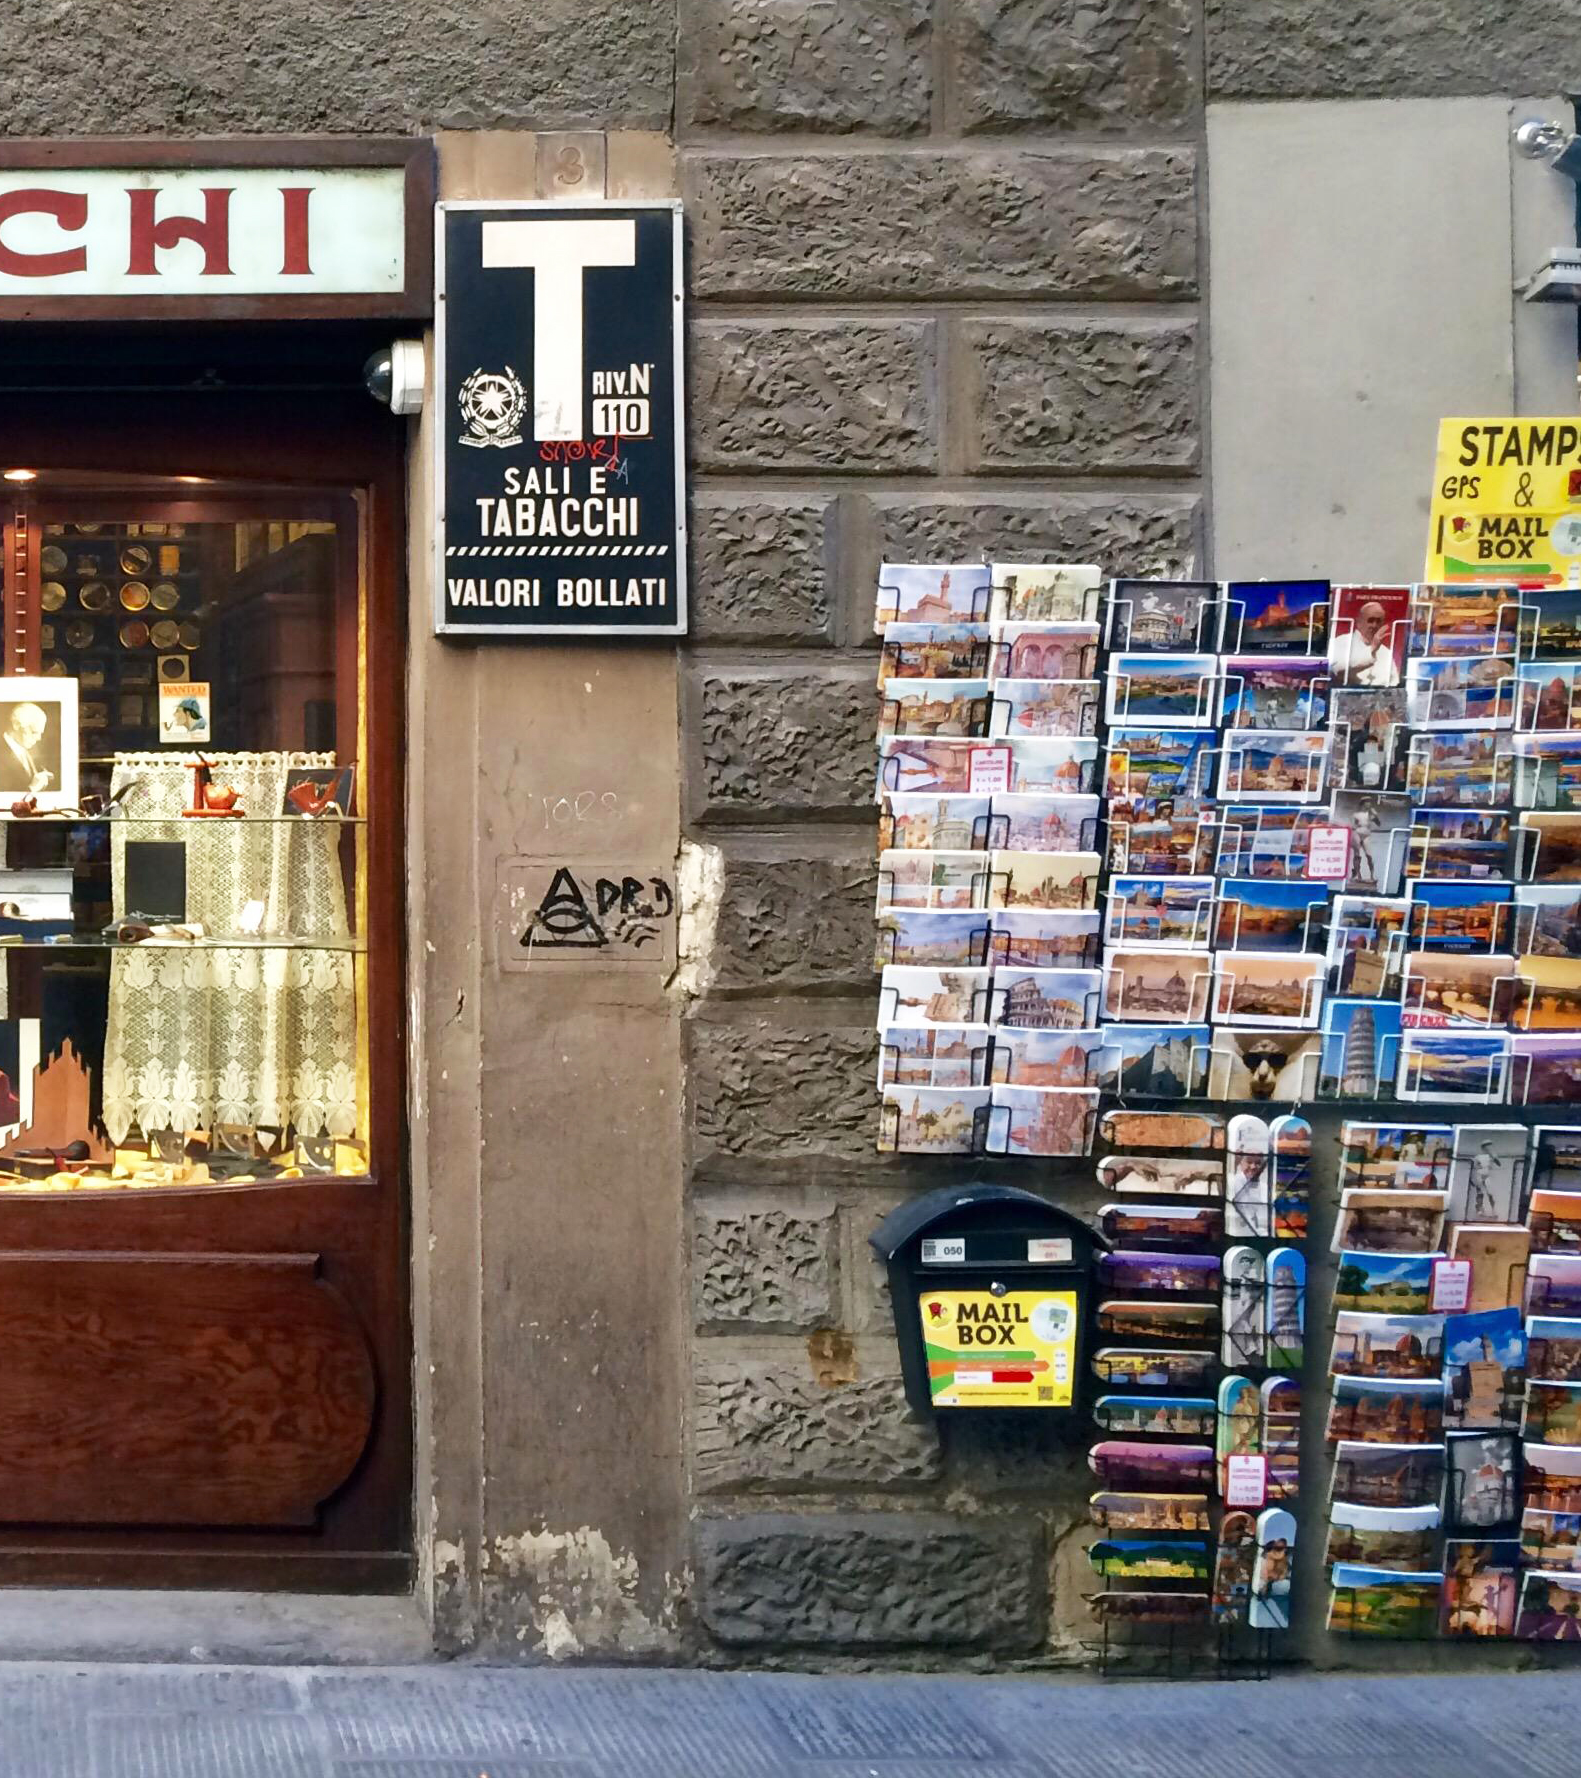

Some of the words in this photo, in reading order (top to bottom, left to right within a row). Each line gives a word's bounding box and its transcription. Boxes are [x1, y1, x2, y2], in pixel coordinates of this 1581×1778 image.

[558, 147, 584, 184] 3
[482, 220, 635, 441] T
[601, 403, 641, 432] 110
[1459, 426, 1581, 466] STAMP
[505, 467, 570, 494] SALI
[590, 467, 606, 494] E
[1442, 475, 1481, 499] GPS
[1515, 472, 1533, 507] &
[477, 499, 637, 536] TABACCHI
[1478, 518, 1548, 537] MAIL
[1478, 540, 1534, 558] BOX
[448, 579, 540, 607] VALORI
[558, 578, 666, 606] BOLLATI
[944, 1246, 962, 1255] 050
[956, 1303, 1029, 1323] MAIL
[957, 1325, 1015, 1345] BOX
